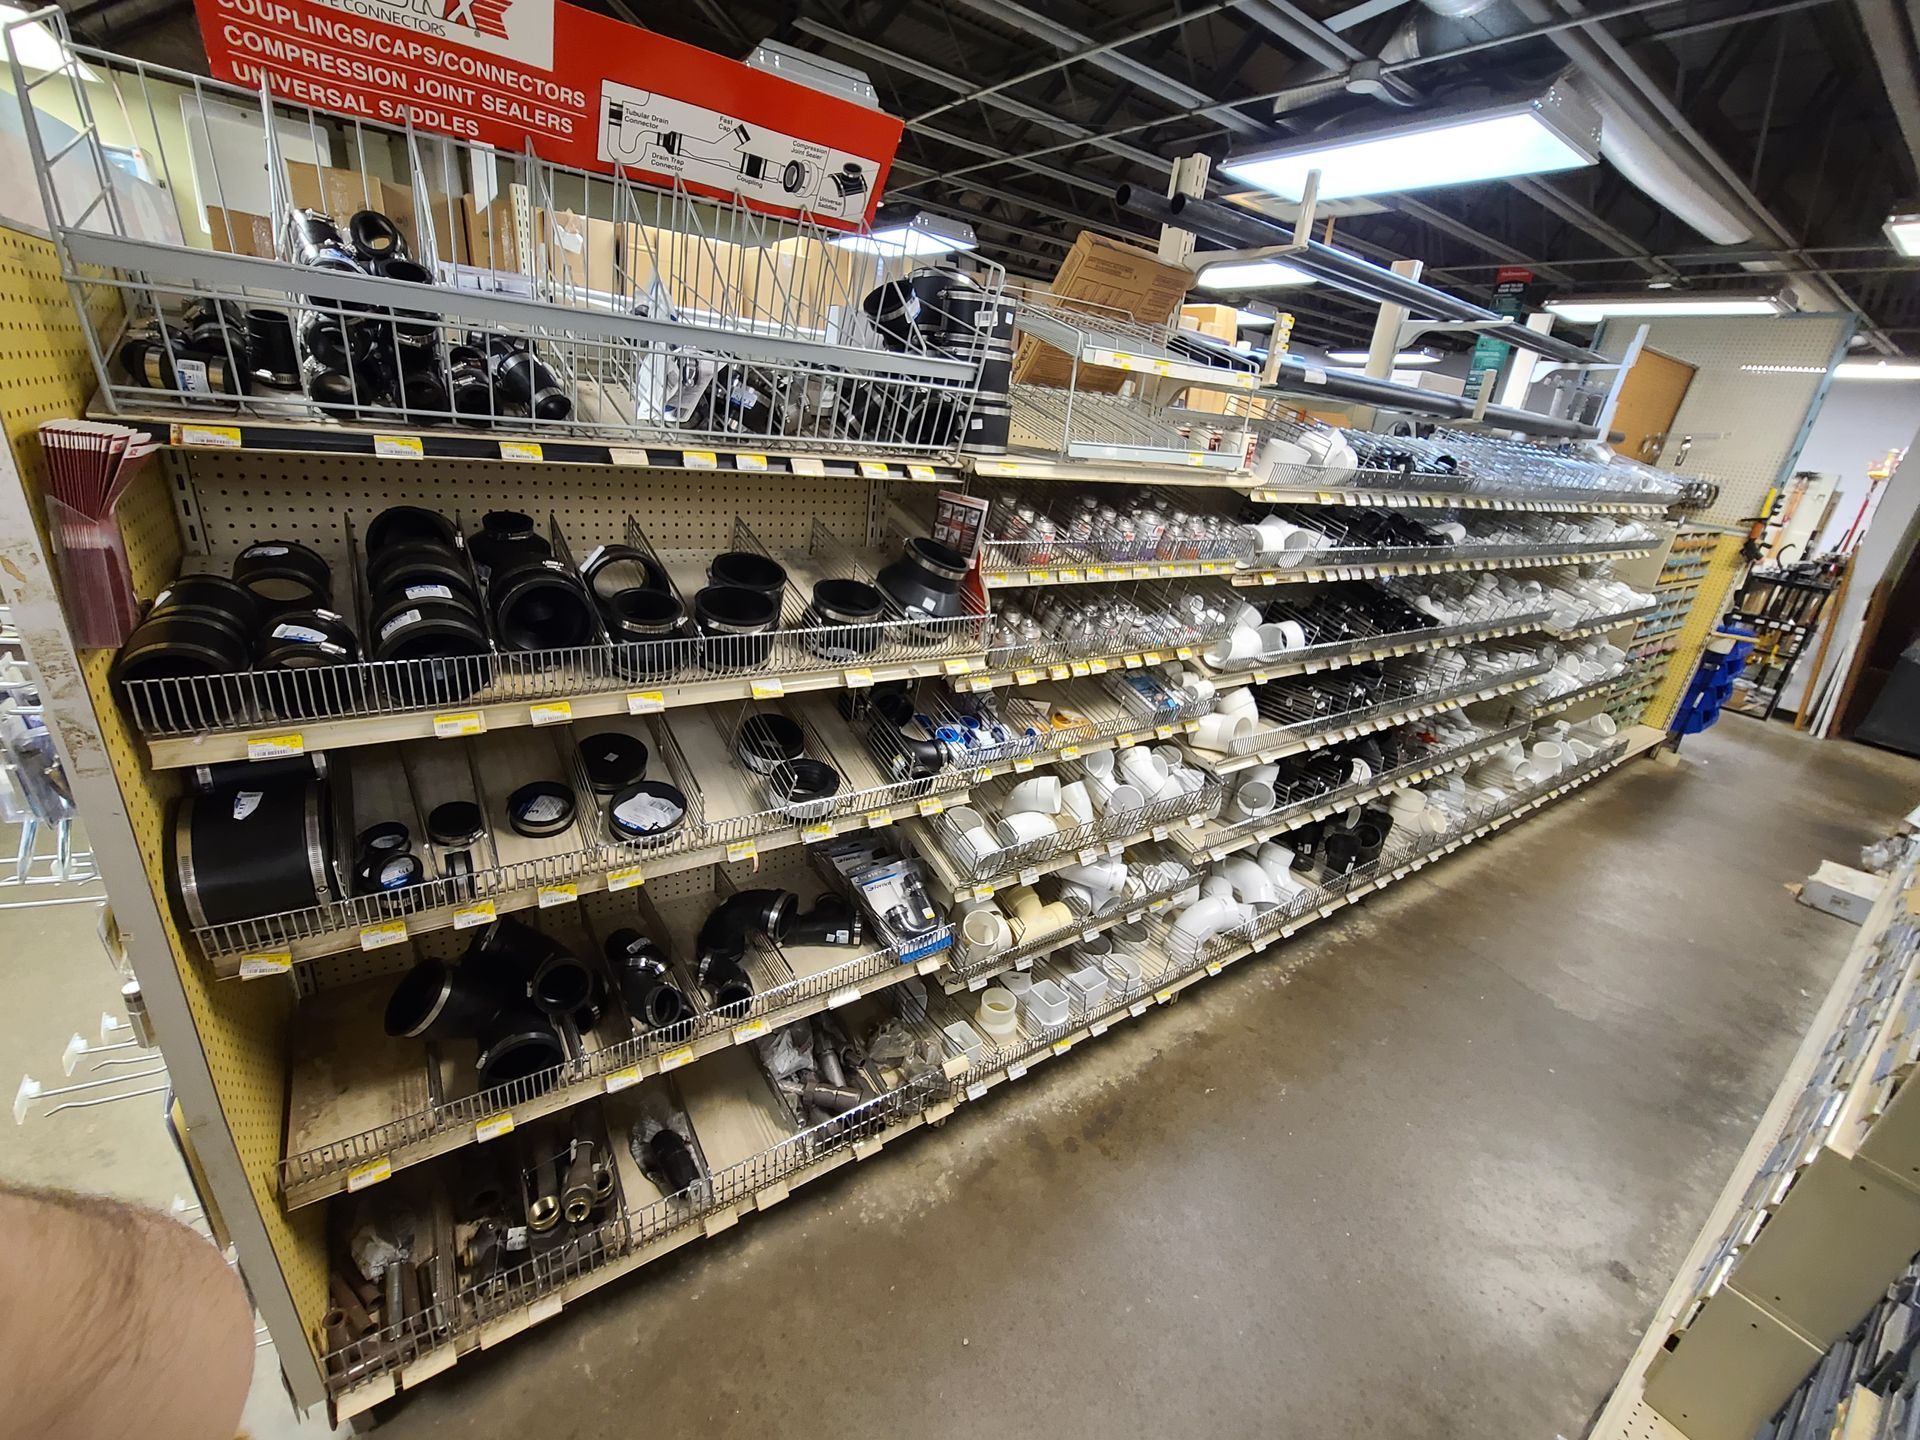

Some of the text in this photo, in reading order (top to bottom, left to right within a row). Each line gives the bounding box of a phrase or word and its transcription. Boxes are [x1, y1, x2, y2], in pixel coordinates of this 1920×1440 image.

[344, 0, 447, 37] CONNECTORS
[223, 25, 573, 134] COMPRESSION JOINT SEALERS
[231, 60, 480, 137] UNIVERSAL SADDLES
[624, 115, 659, 130] Connector
[625, 108, 669, 125] Tubular Drain
[720, 115, 733, 125] Fast
[718, 123, 731, 132] Cap
[792, 140, 828, 154] Compression
[651, 152, 685, 167] Drain Trap
[651, 159, 684, 173] Connector
[736, 174, 763, 189] Coupling
